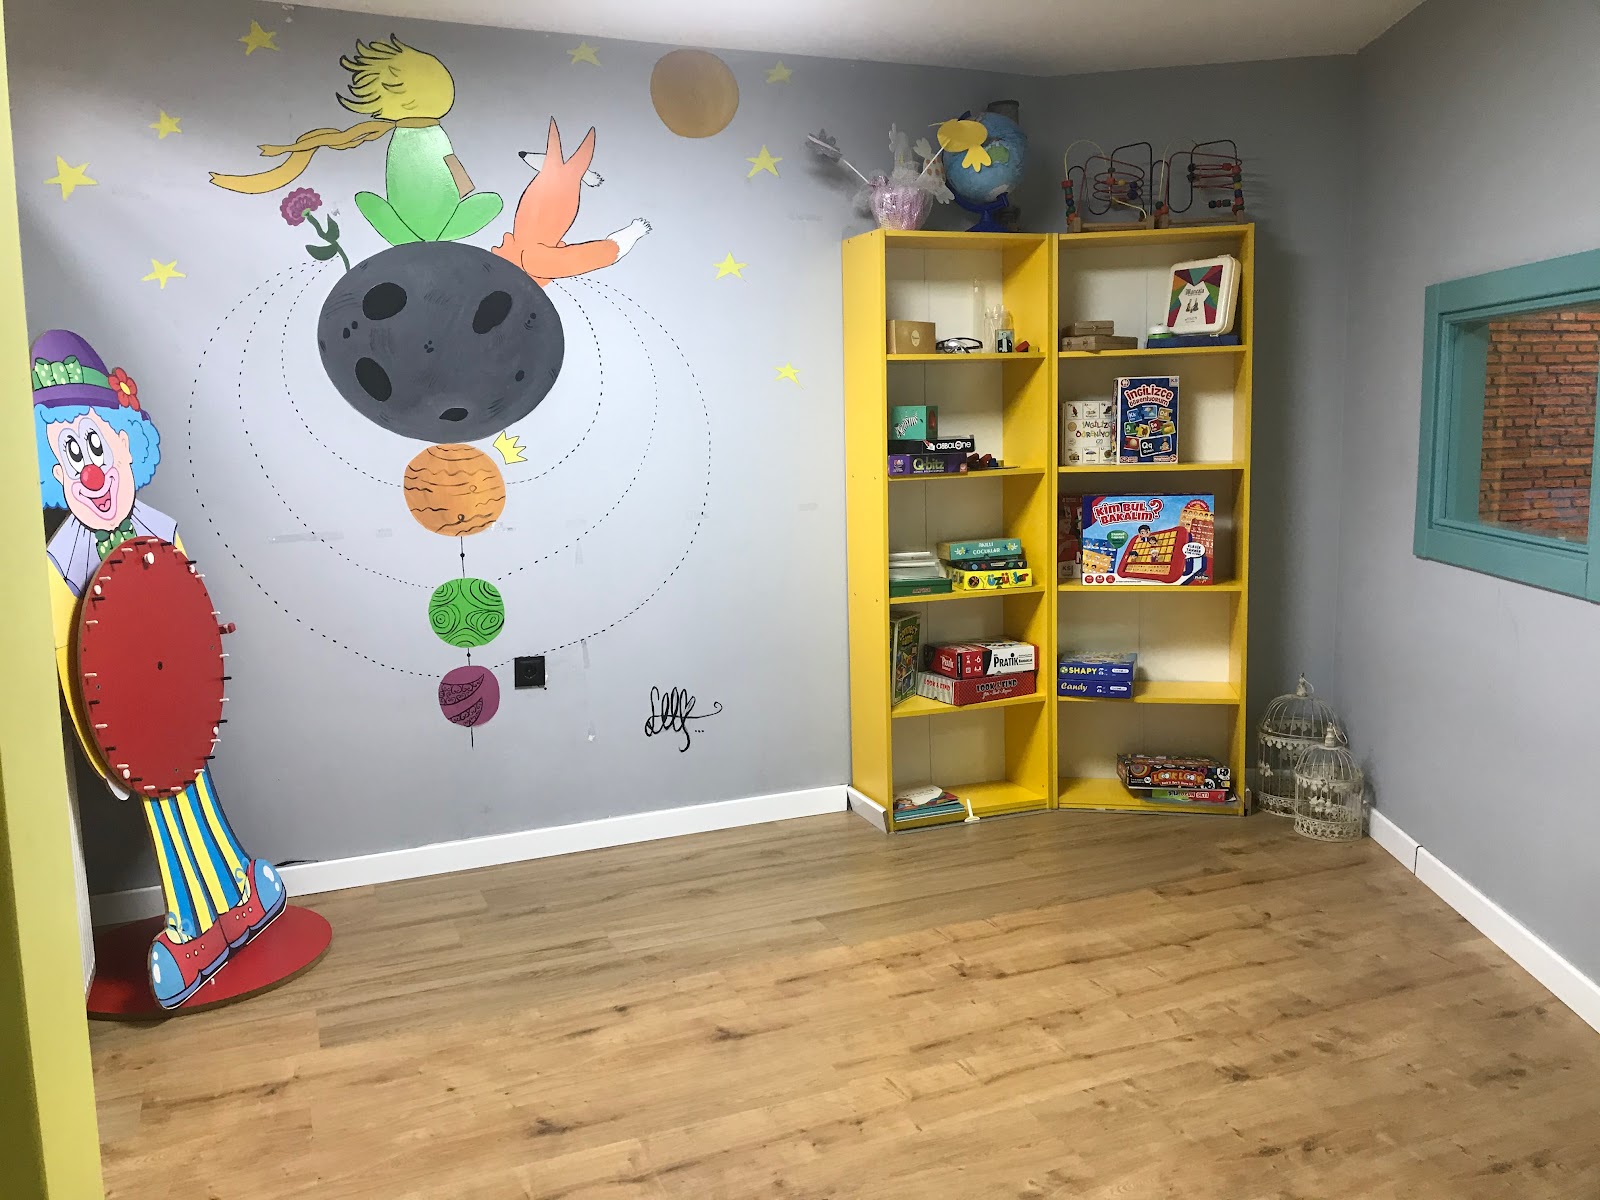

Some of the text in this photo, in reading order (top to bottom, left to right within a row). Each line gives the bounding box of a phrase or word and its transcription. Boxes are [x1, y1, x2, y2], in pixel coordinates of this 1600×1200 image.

[1123, 503, 1146, 511] BUL
[1068, 666, 1097, 675] SHAPY
[1061, 682, 1088, 692] Candy
